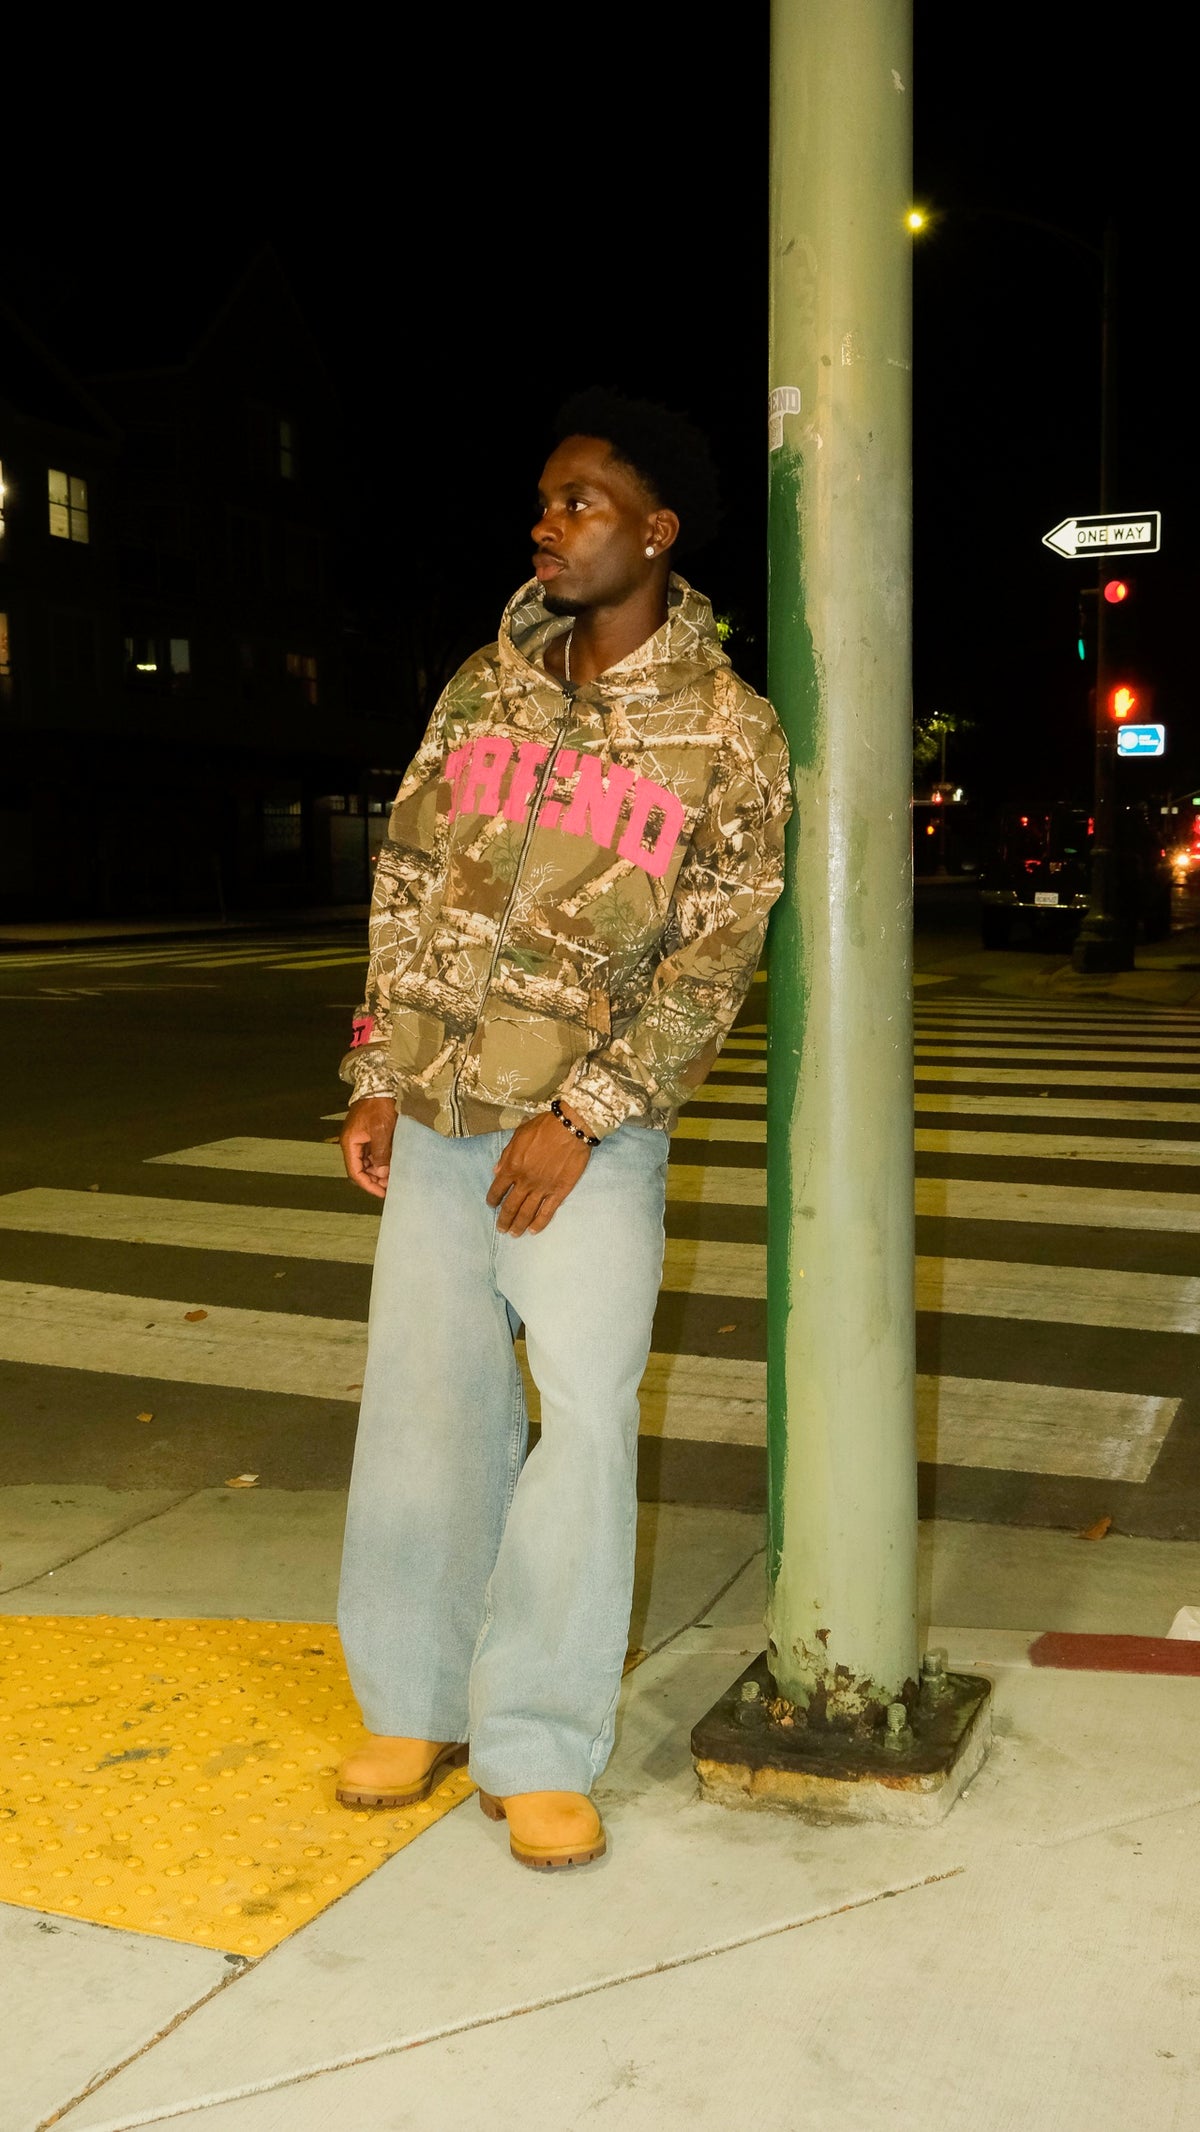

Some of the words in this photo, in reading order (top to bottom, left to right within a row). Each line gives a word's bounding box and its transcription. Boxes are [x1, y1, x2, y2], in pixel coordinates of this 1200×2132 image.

[769, 389, 800, 412] END
[1077, 529, 1107, 544] ONE
[1113, 526, 1145, 541] WAY
